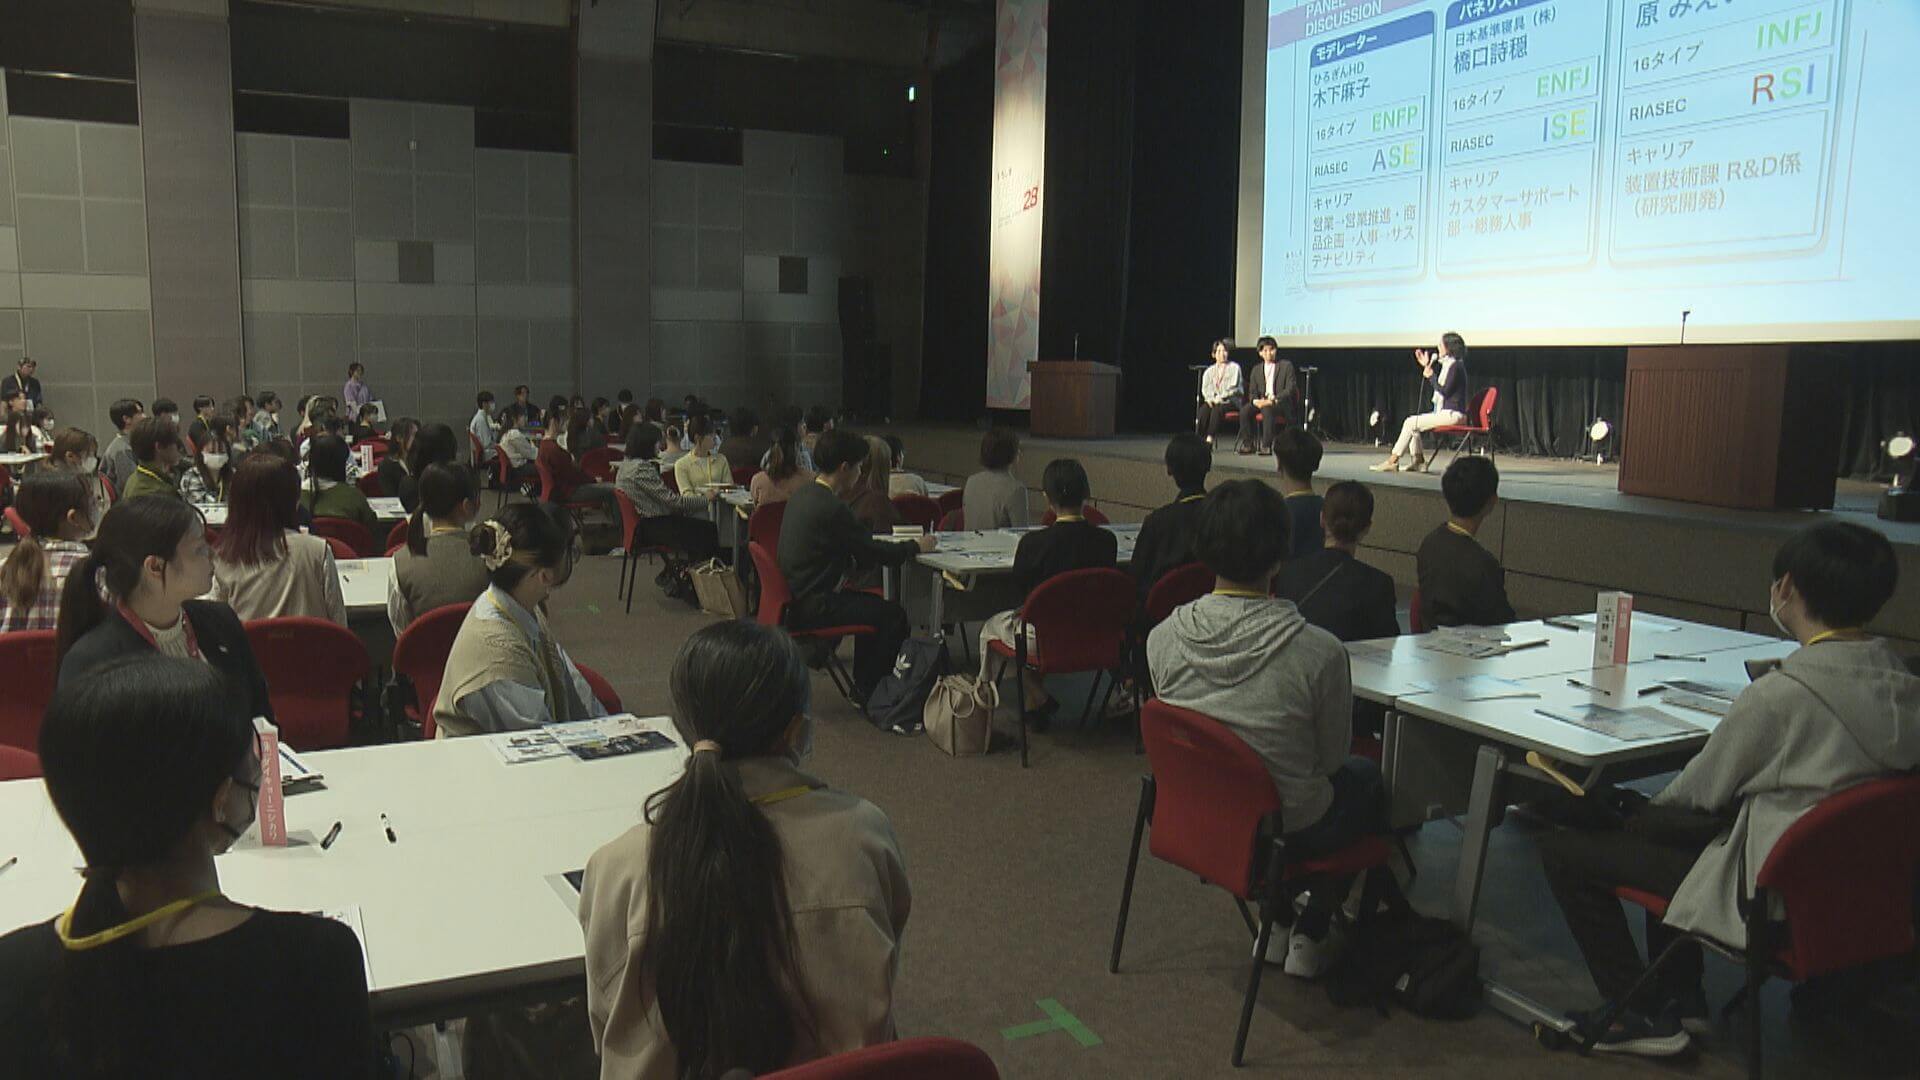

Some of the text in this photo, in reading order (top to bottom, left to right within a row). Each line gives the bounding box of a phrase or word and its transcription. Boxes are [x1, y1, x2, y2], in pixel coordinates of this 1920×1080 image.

[1306, 0, 1382, 37] DISCUSSION
[1317, 33, 1378, 61] モデレーター
[1633, 11, 1823, 73] 16タイプ INFJ
[1314, 61, 1365, 86] ひろぎんHD
[1453, 65, 1591, 112] 16タイプ ENFJ
[1313, 77, 1371, 109] 木下麻子
[1629, 63, 1815, 121] RIASEC RSI
[1316, 105, 1419, 141] 16タイプ ENFP
[1450, 109, 1587, 153] RIASEC ISE
[1314, 142, 1416, 177] RIASEC ASE
[1627, 140, 1694, 166] キャリア
[1450, 170, 1500, 192] キャリア
[1313, 193, 1353, 211] キャリア
[1448, 183, 1580, 216] カスタマーサポート
